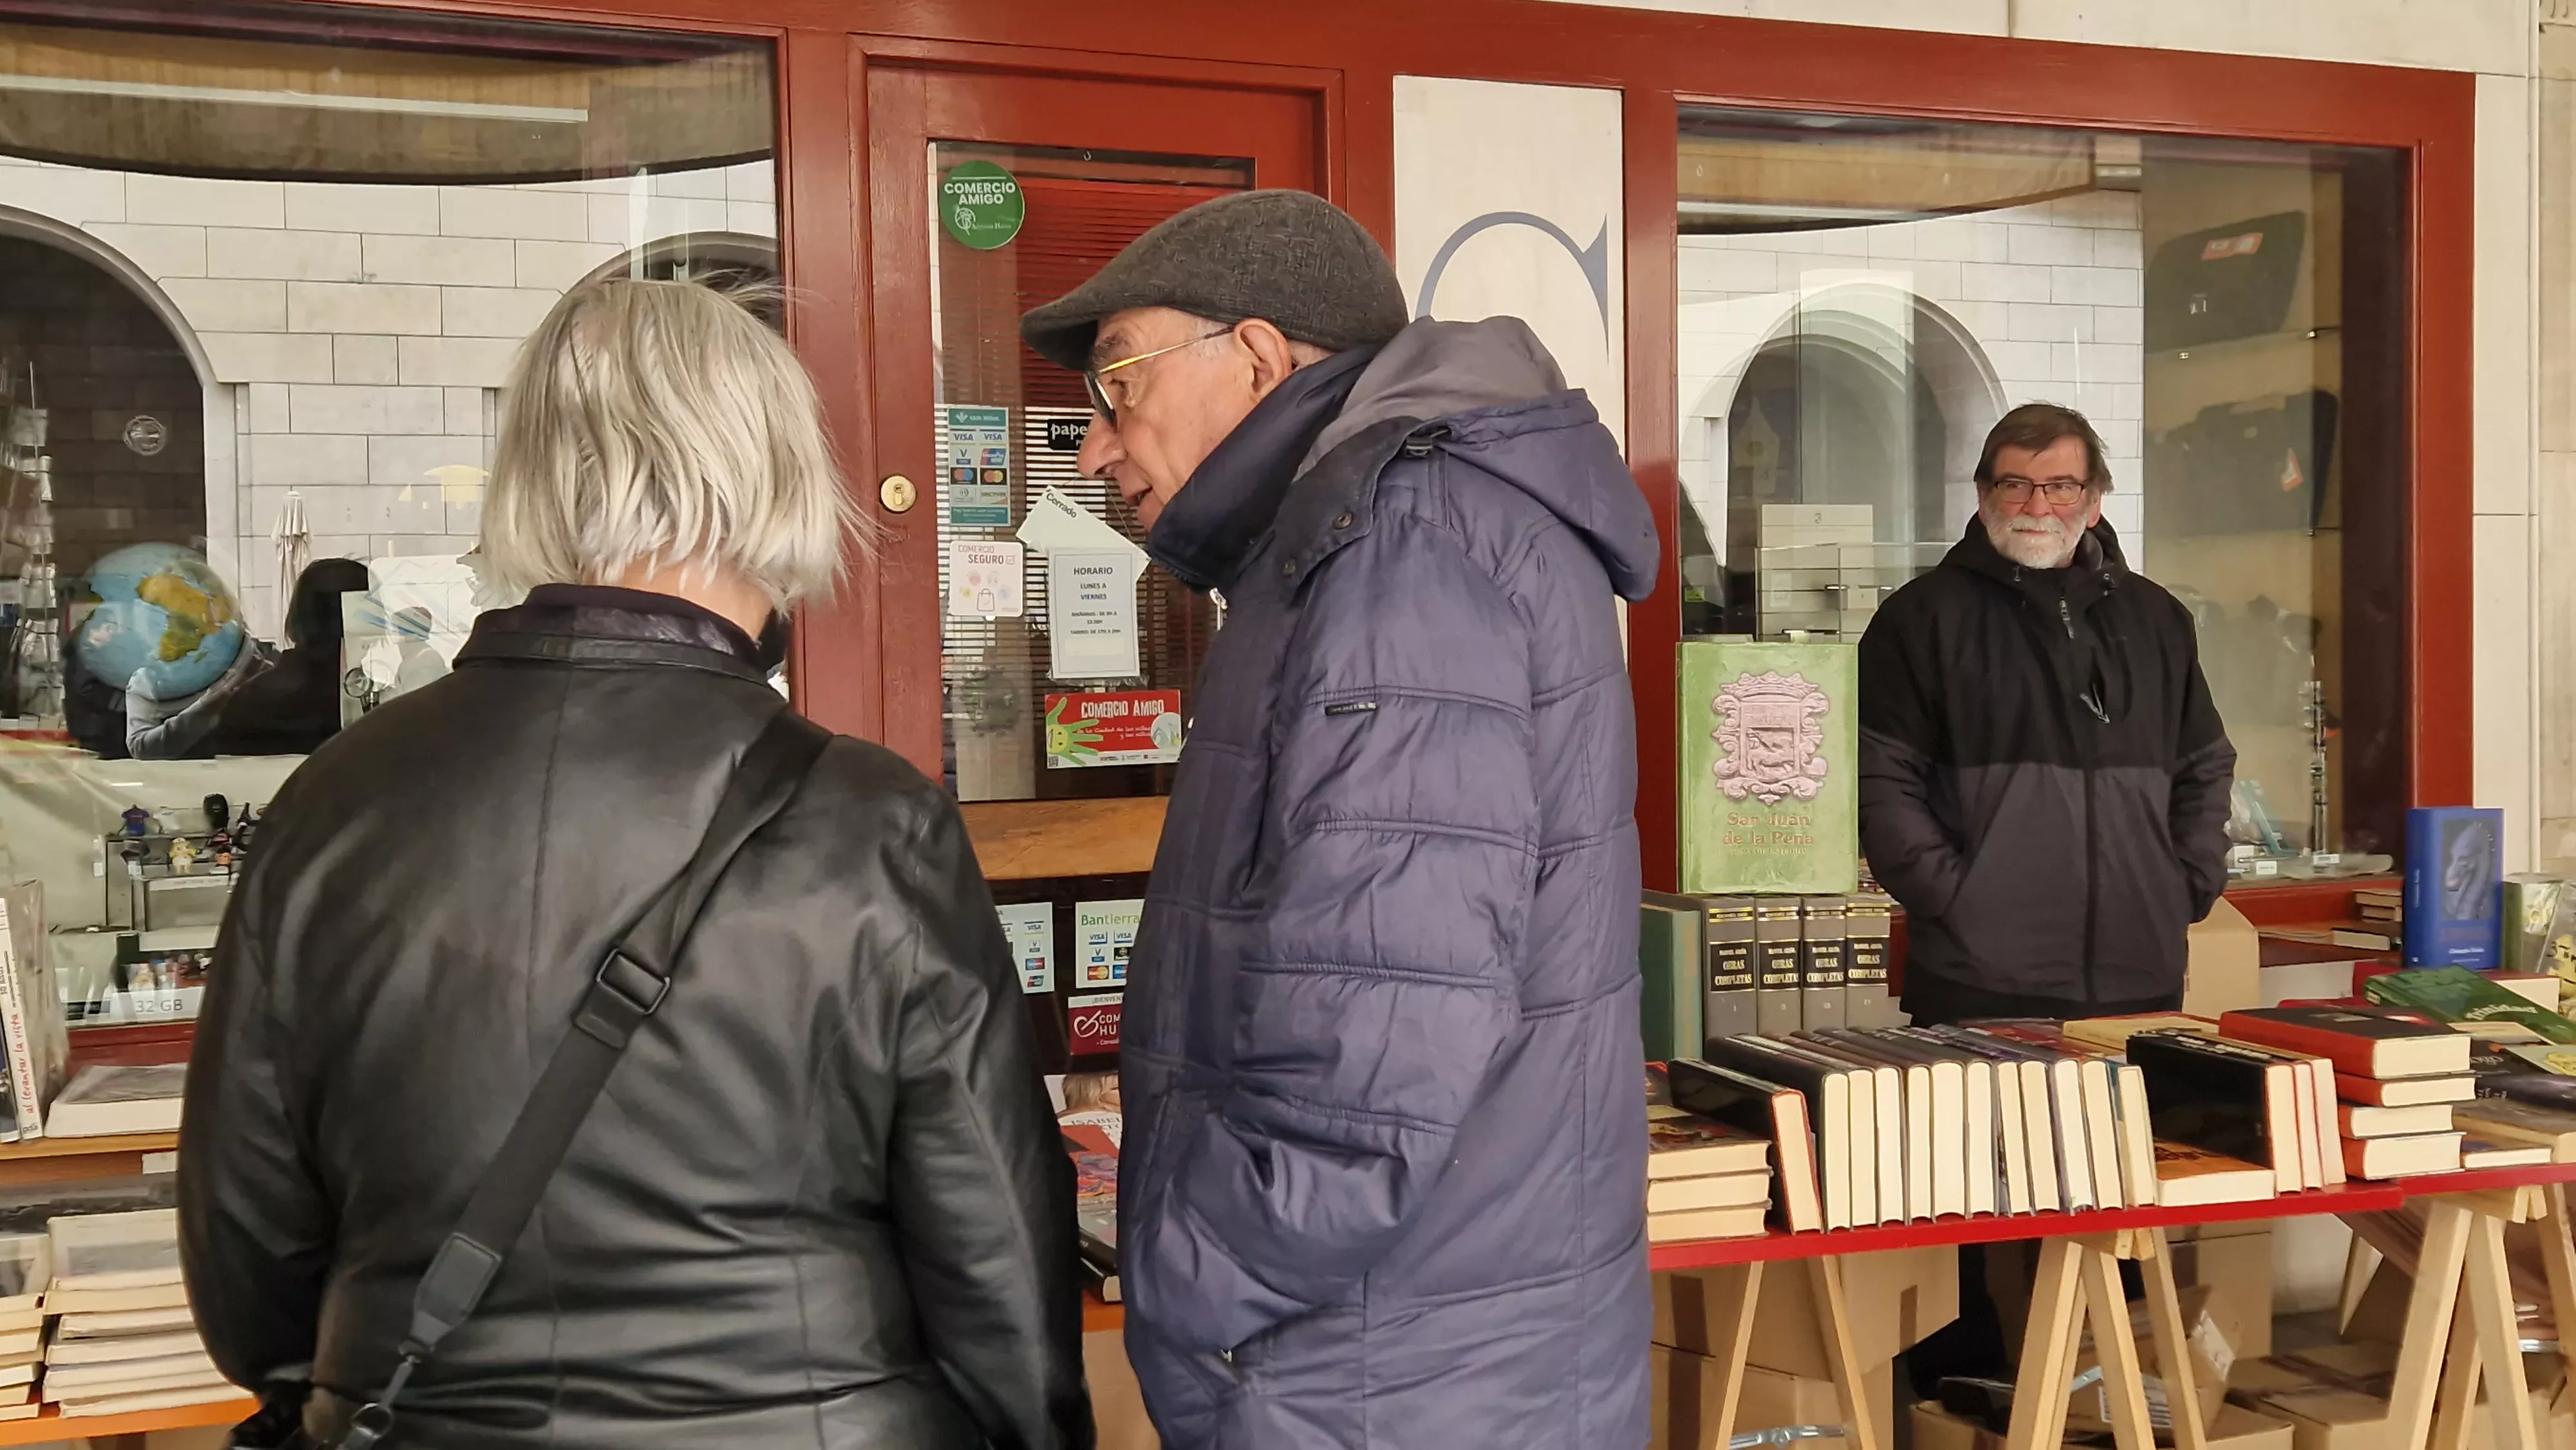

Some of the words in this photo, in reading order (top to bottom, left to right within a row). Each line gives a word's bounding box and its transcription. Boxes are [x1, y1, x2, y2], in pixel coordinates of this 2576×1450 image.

[944, 182, 1016, 194] COMERCIO
[958, 193, 1004, 205] AMIGO
[1046, 492, 1077, 518] Cerrado
[968, 554, 1003, 564] SEGURO
[1081, 701, 1128, 719] COMERCIO
[1133, 699, 1164, 717] AMIGO
[1727, 812, 1761, 826] San
[1768, 812, 1811, 826] Juan
[1723, 831, 1743, 844] de
[1751, 829, 1765, 844] la
[1772, 831, 1814, 845] Peña
[1081, 914, 1139, 925] Bantierra
[1723, 959, 1745, 970] OBRAS
[1772, 959, 1794, 968] OBRAS
[1815, 958, 1838, 968] OBRAS
[1857, 955, 1880, 964] OBRAS
[1763, 973, 1799, 984] COMPLETAS
[1806, 972, 1844, 983] COMPLETAS
[1848, 968, 1887, 978] COMPLETAS
[1715, 974, 1752, 986] COMPLETAS
[136, 1000, 155, 1012] 32
[161, 999, 183, 1012] GB
[10, 1013, 23, 1039] vista
[13, 1042, 24, 1053] la
[17, 1057, 32, 1100] levantar
[23, 1104, 33, 1114] al
